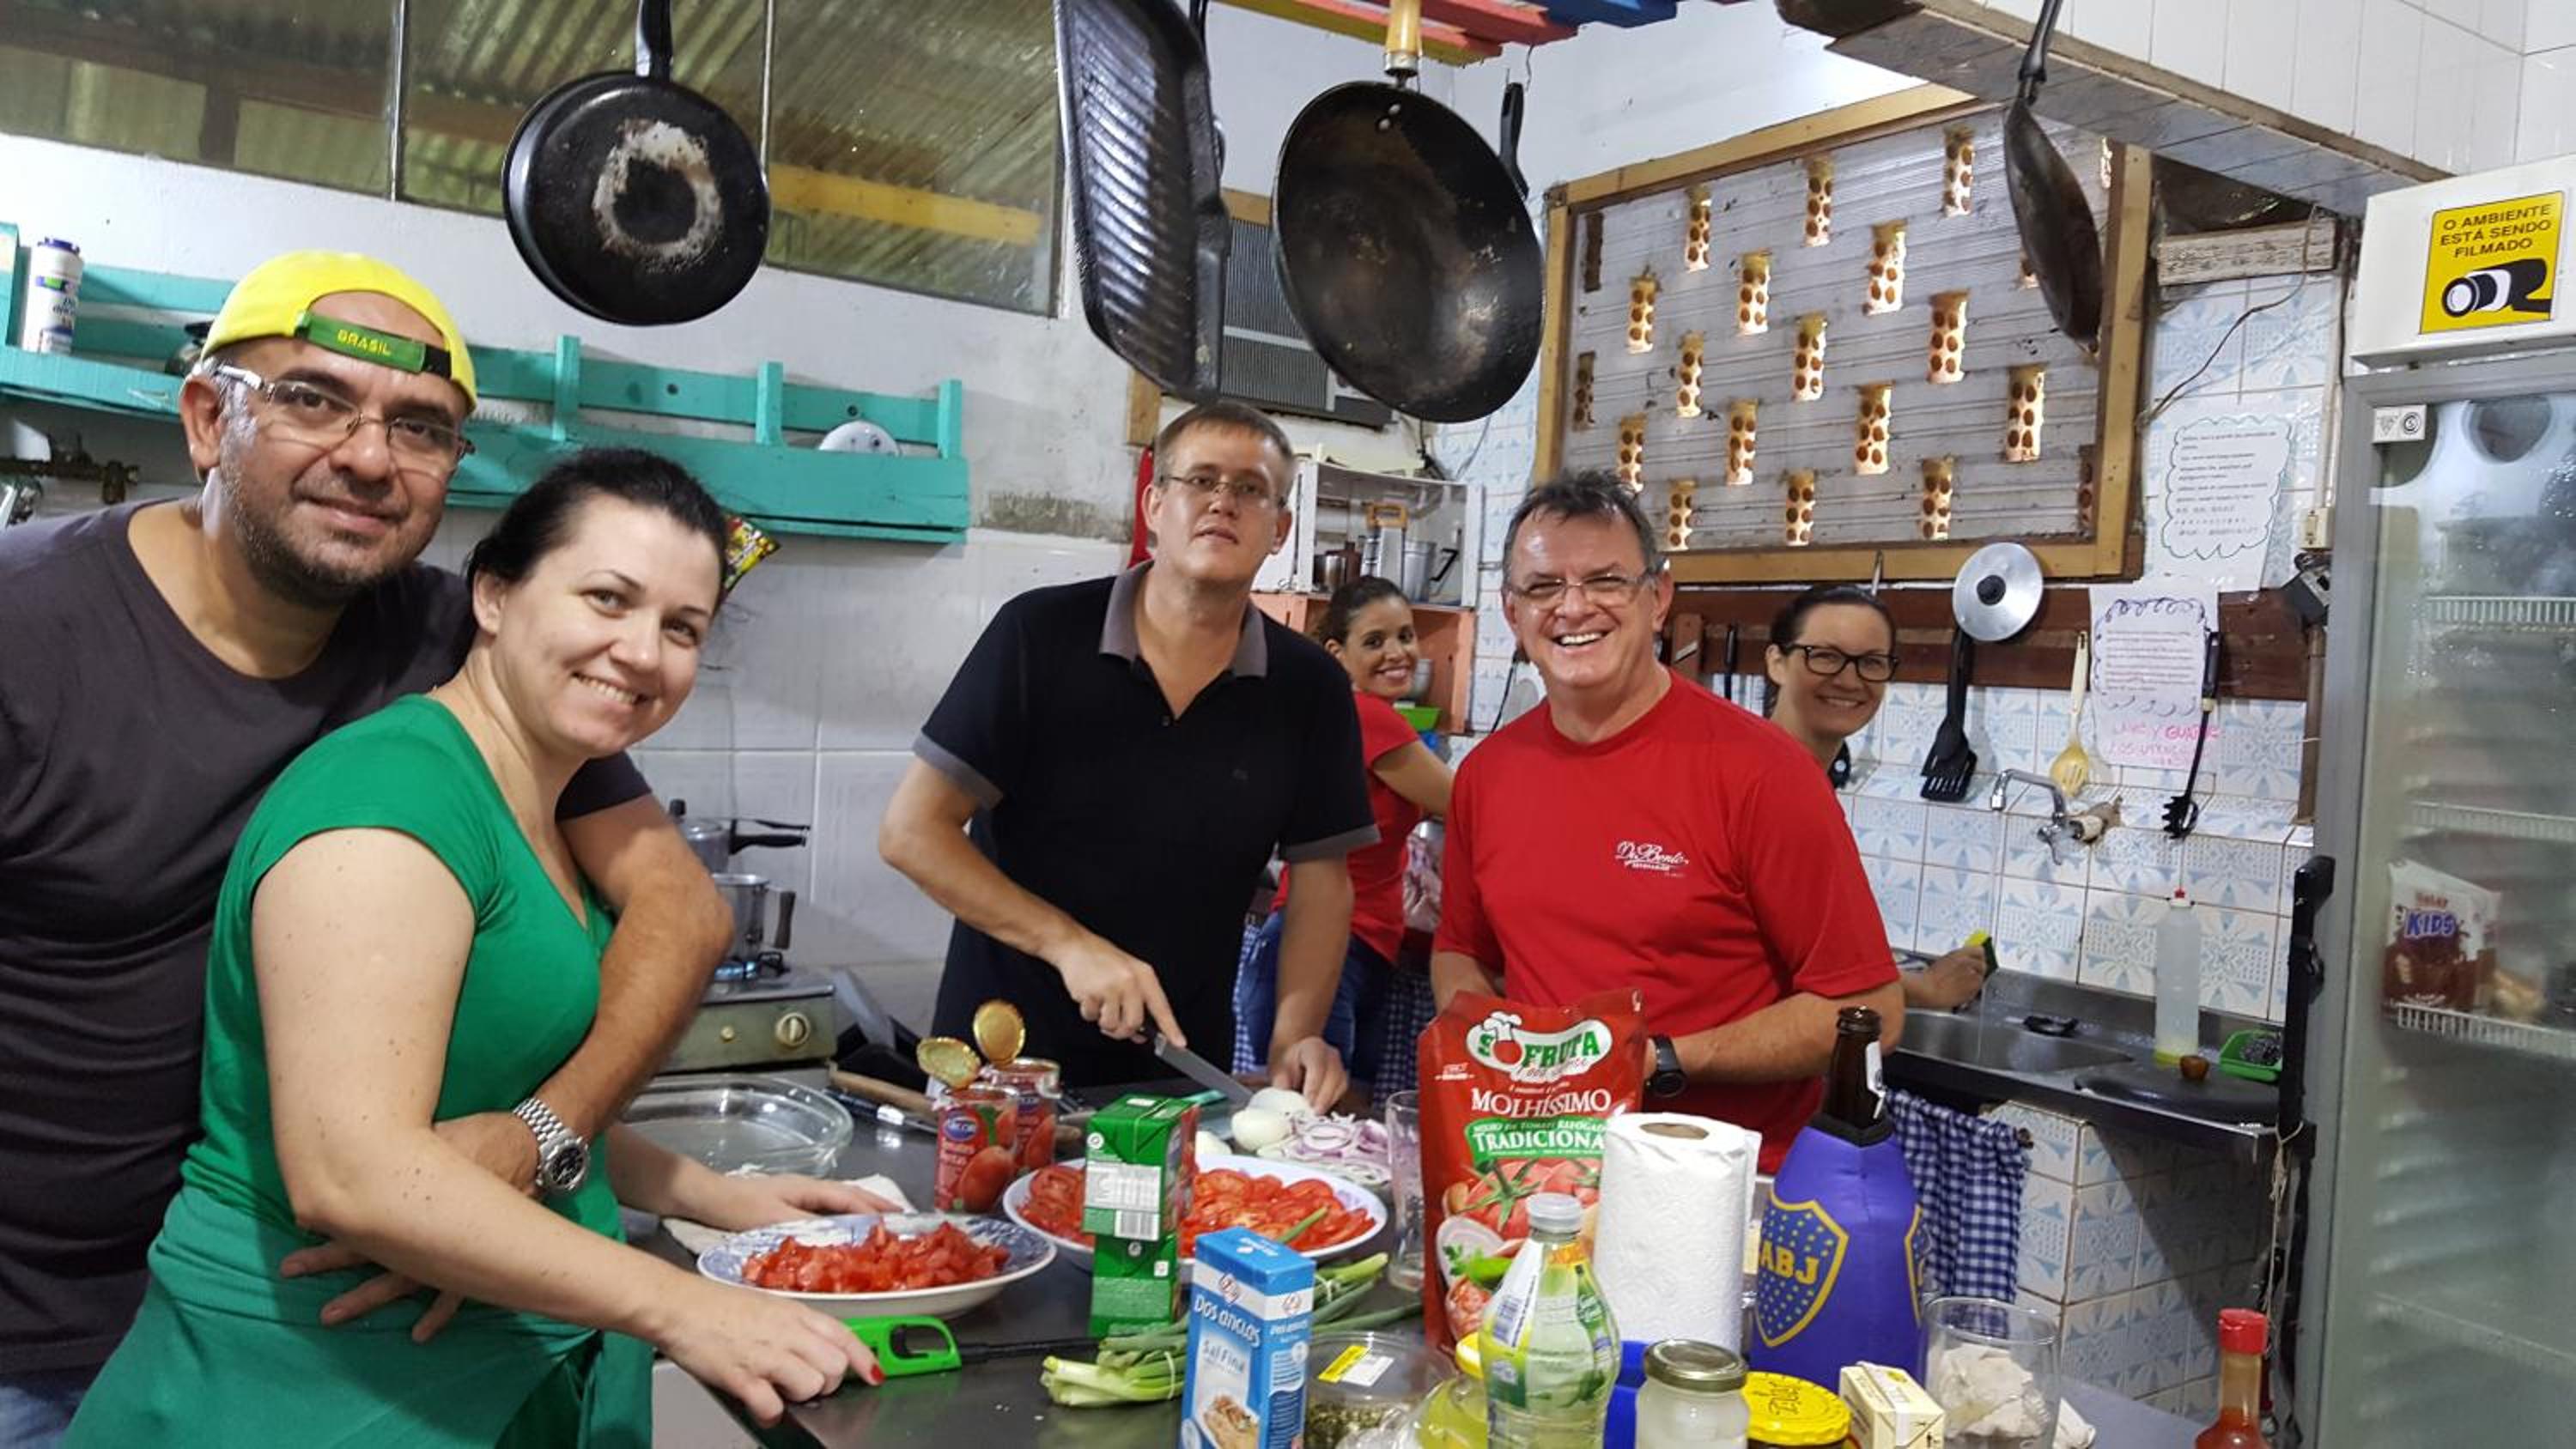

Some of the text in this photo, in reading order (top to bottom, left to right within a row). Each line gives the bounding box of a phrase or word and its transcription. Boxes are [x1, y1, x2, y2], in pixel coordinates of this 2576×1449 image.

[2443, 203, 2551, 231] O AMBIENTE
[2488, 219, 2551, 239] SENDO
[2454, 237, 2533, 258] FILMADO
[337, 329, 392, 356] BRASIL
[2165, 724, 2221, 740] GUARE
[2407, 912, 2457, 937] KIDS
[1473, 1130, 1606, 1153] TRADICIONA
